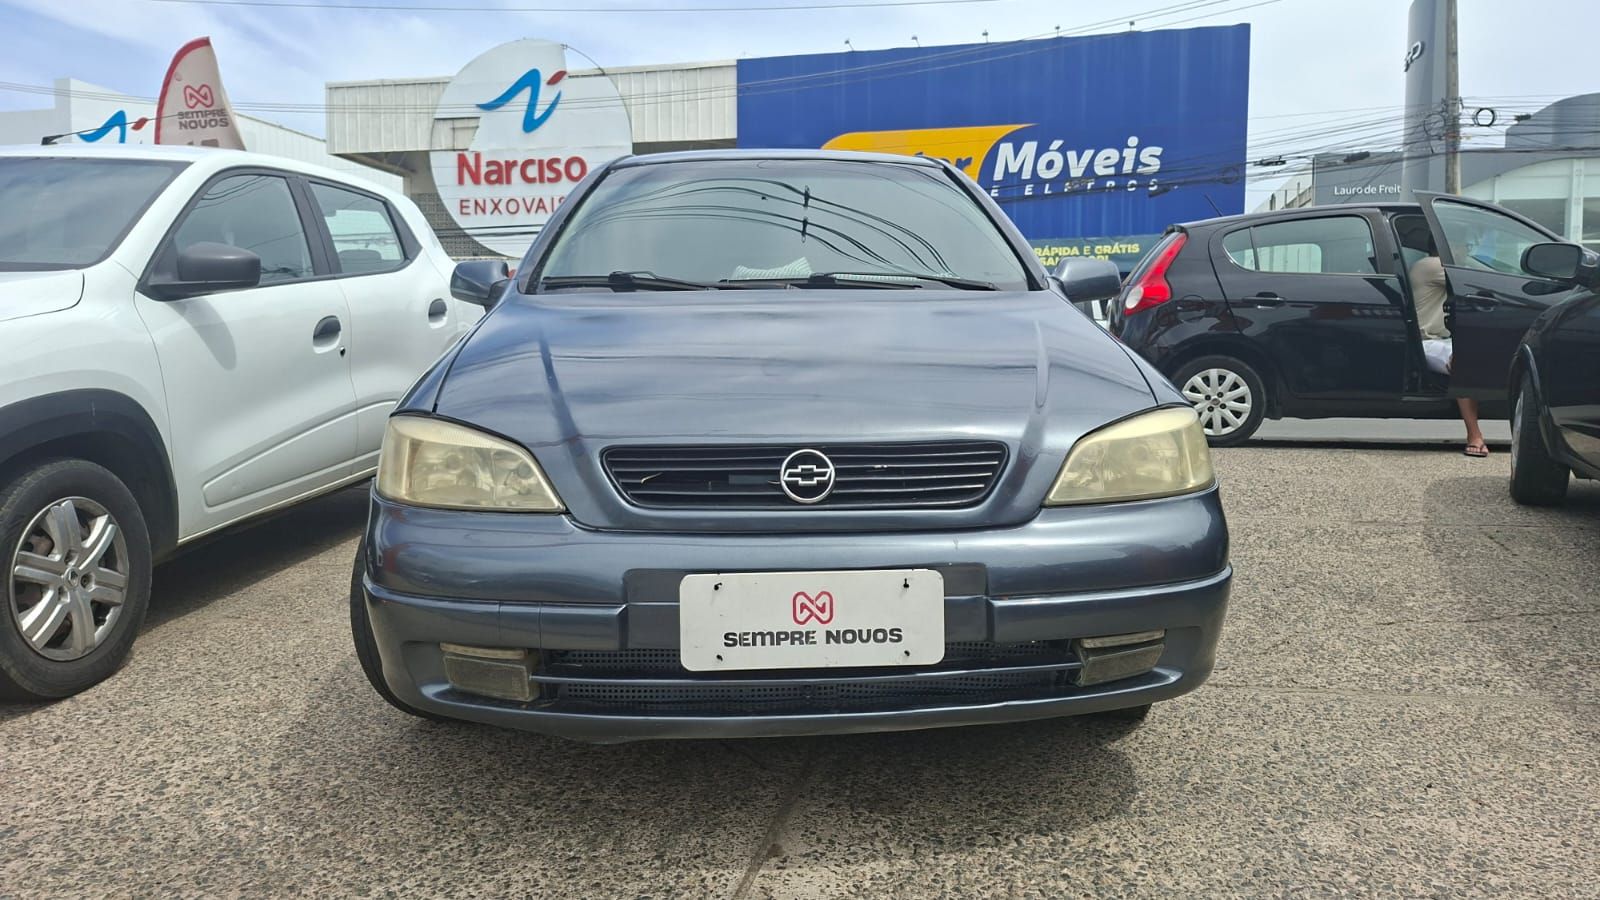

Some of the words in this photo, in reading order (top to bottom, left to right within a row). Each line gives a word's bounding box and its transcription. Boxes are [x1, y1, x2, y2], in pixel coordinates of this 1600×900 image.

[178, 108, 228, 119] SEMPRE
[993, 136, 1163, 181] Móveis
[457, 152, 587, 185] Narciso
[1334, 185, 1362, 195] Lauro
[1364, 184, 1376, 194] de
[1034, 245, 1079, 257] RÁPIDA
[1083, 246, 1091, 255] E
[1094, 242, 1140, 254] GRÁTIS
[723, 630, 817, 648] SEMPRE
